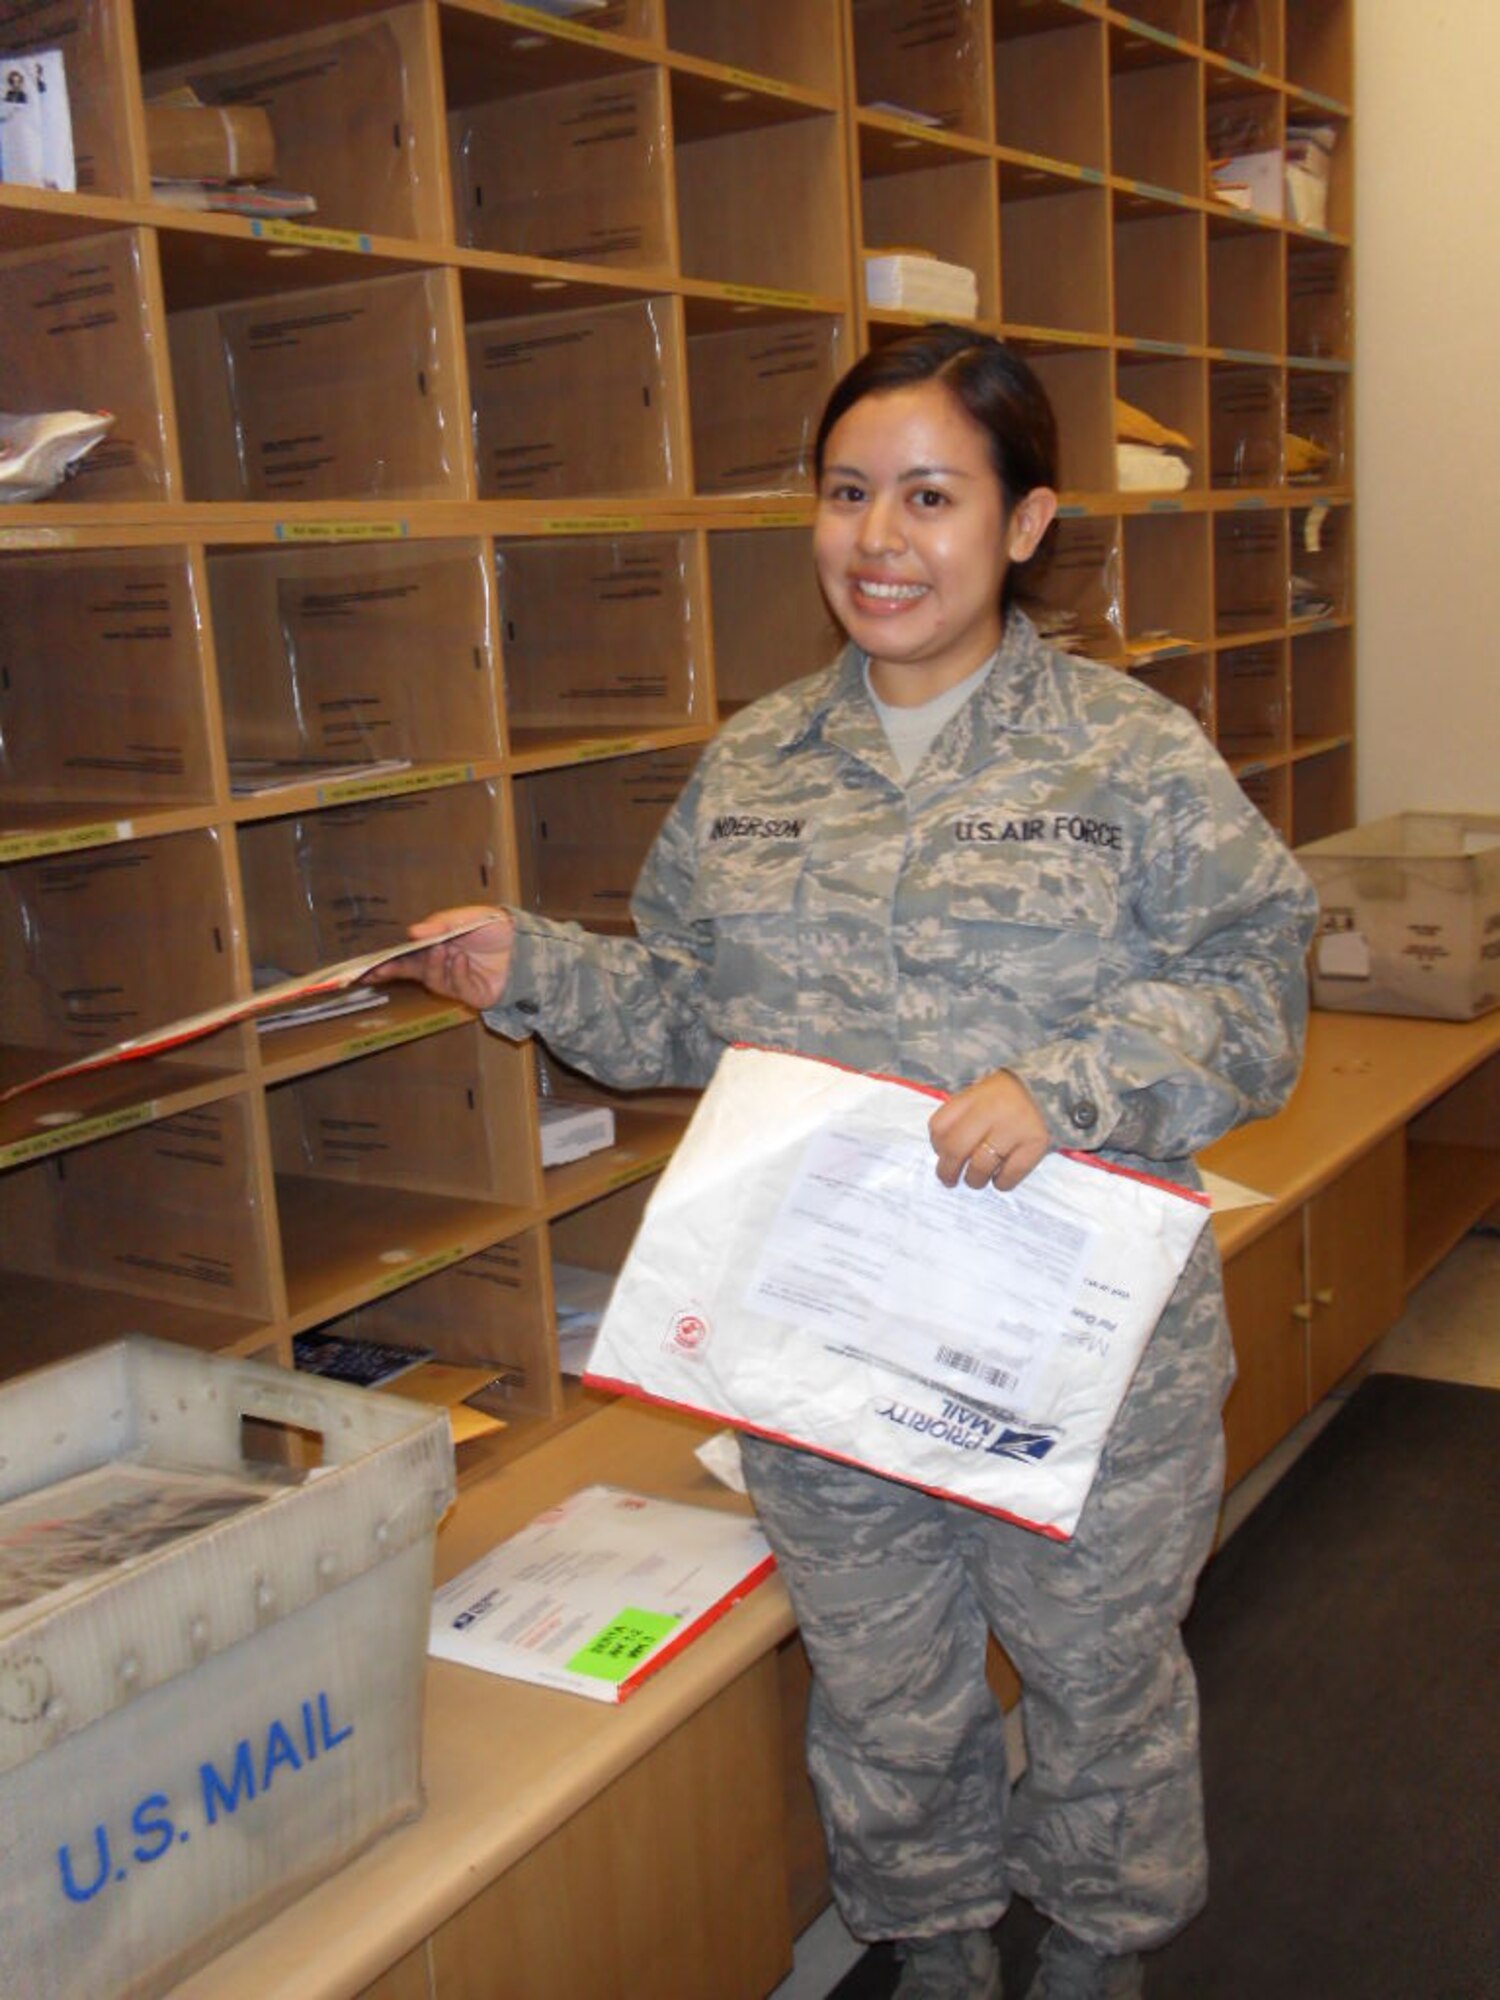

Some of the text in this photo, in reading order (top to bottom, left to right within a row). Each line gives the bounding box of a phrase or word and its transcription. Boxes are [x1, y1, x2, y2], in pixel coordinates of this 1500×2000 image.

[709, 815, 805, 840] NDERSON
[1054, 815, 1123, 850] FORCE
[878, 1402, 996, 1452] PRIORITY
[942, 1399, 996, 1436] MAIL
[57, 1691, 355, 1903] U.S. MAIL
